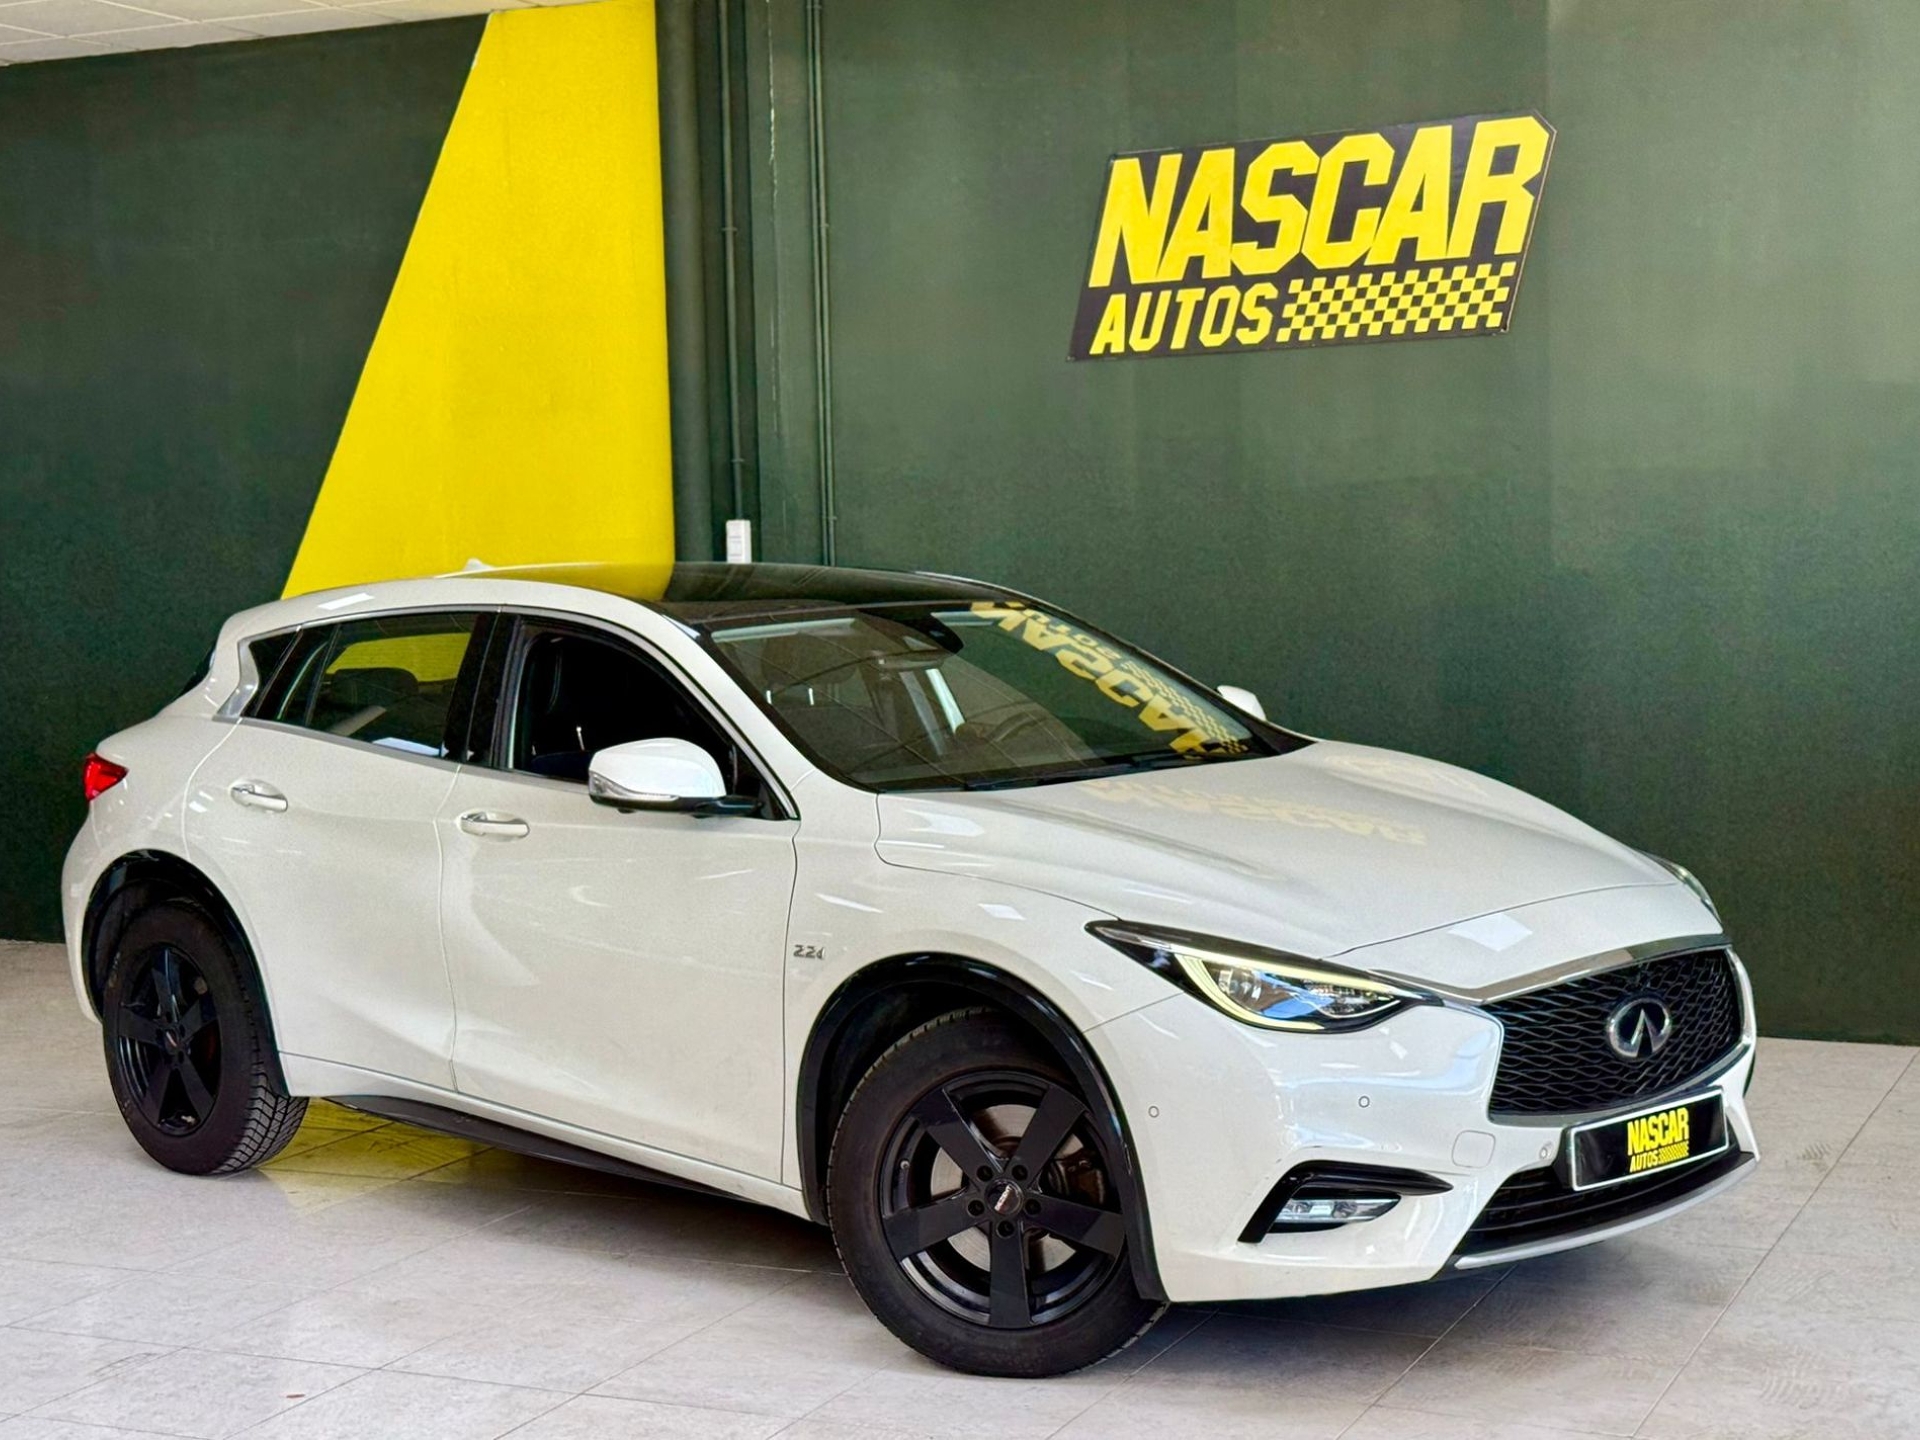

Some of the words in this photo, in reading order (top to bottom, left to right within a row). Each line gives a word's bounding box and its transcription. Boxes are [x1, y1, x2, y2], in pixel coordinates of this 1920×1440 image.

[1089, 115, 1550, 288] NASCAR
[1089, 282, 1279, 355] AUTOS
[1626, 1107, 1690, 1156] NASCAR
[1629, 1152, 1660, 1173] AUTOS
